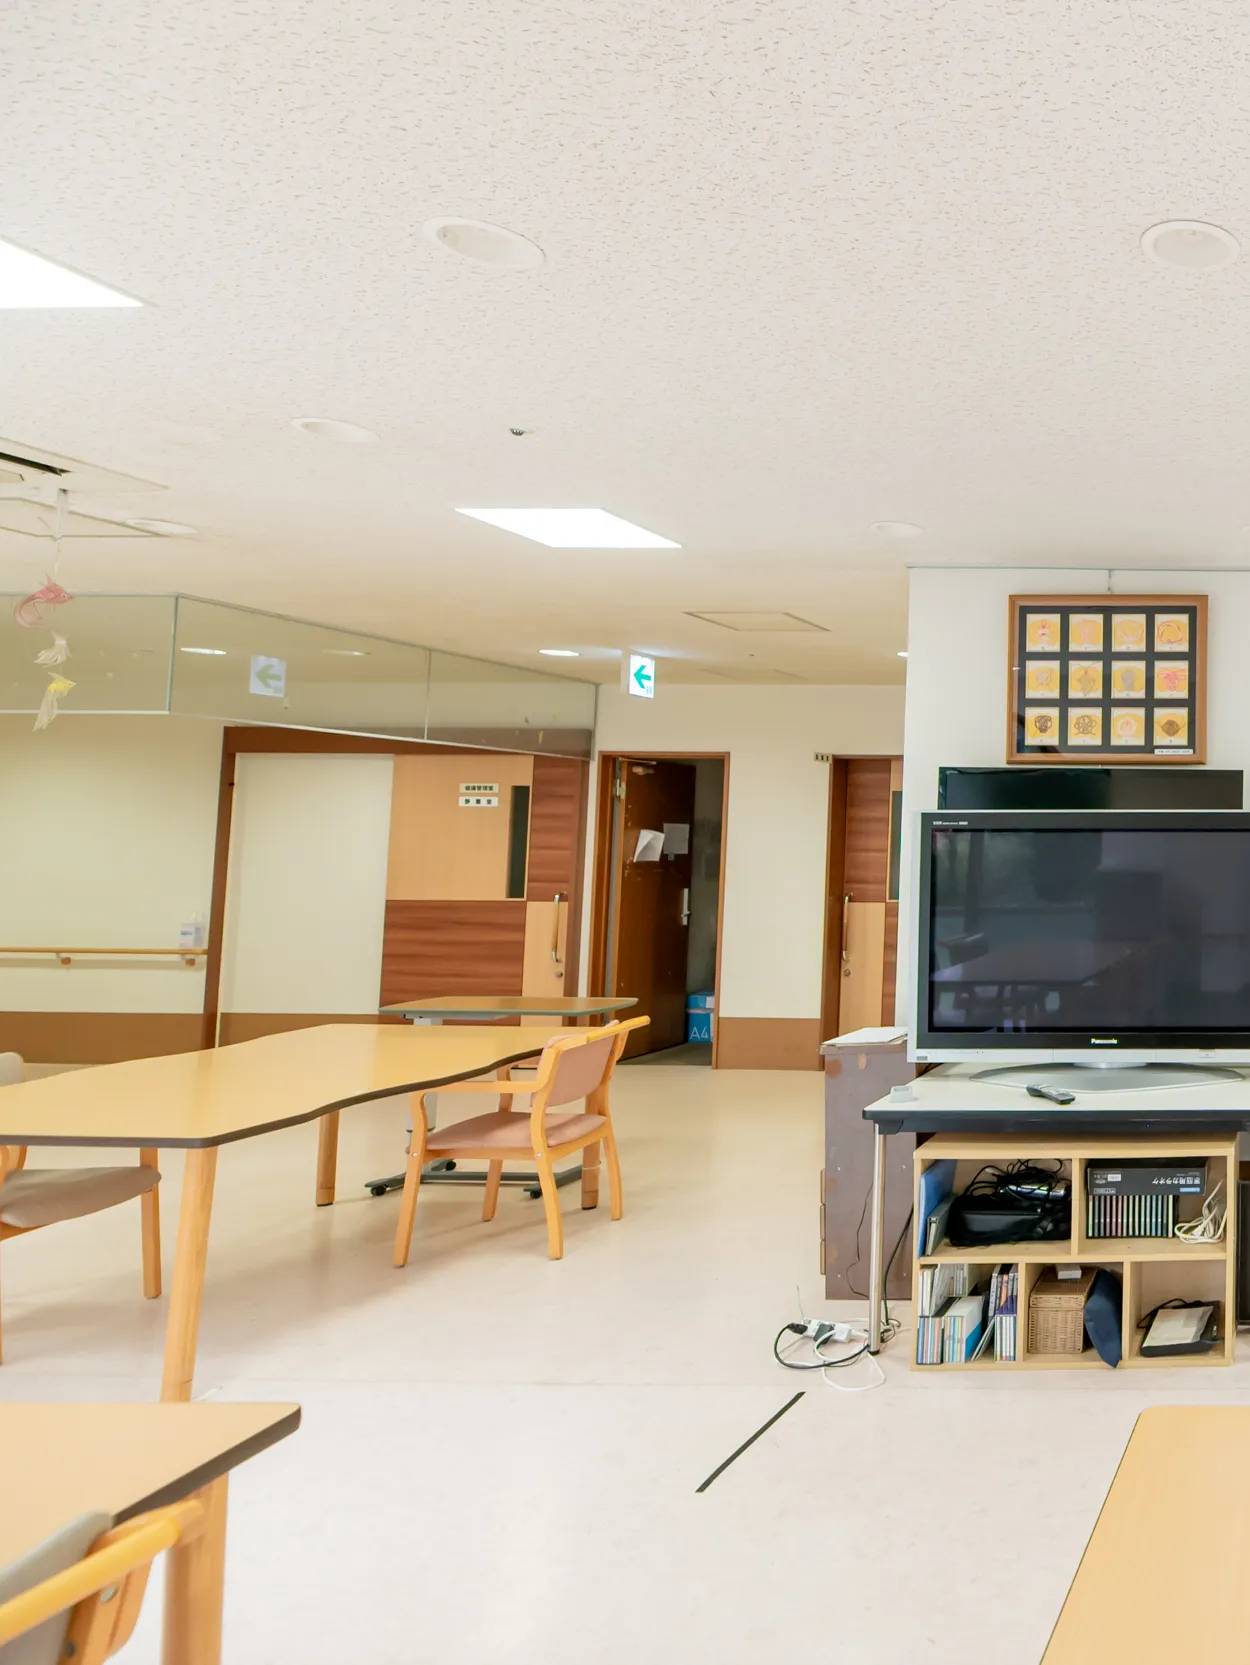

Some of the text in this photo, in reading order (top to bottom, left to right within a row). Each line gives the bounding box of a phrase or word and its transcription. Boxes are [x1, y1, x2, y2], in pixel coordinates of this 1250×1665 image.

[689, 1026, 708, 1040] A4
[1152, 1177, 1201, 1185] 家庭用カラオケ
